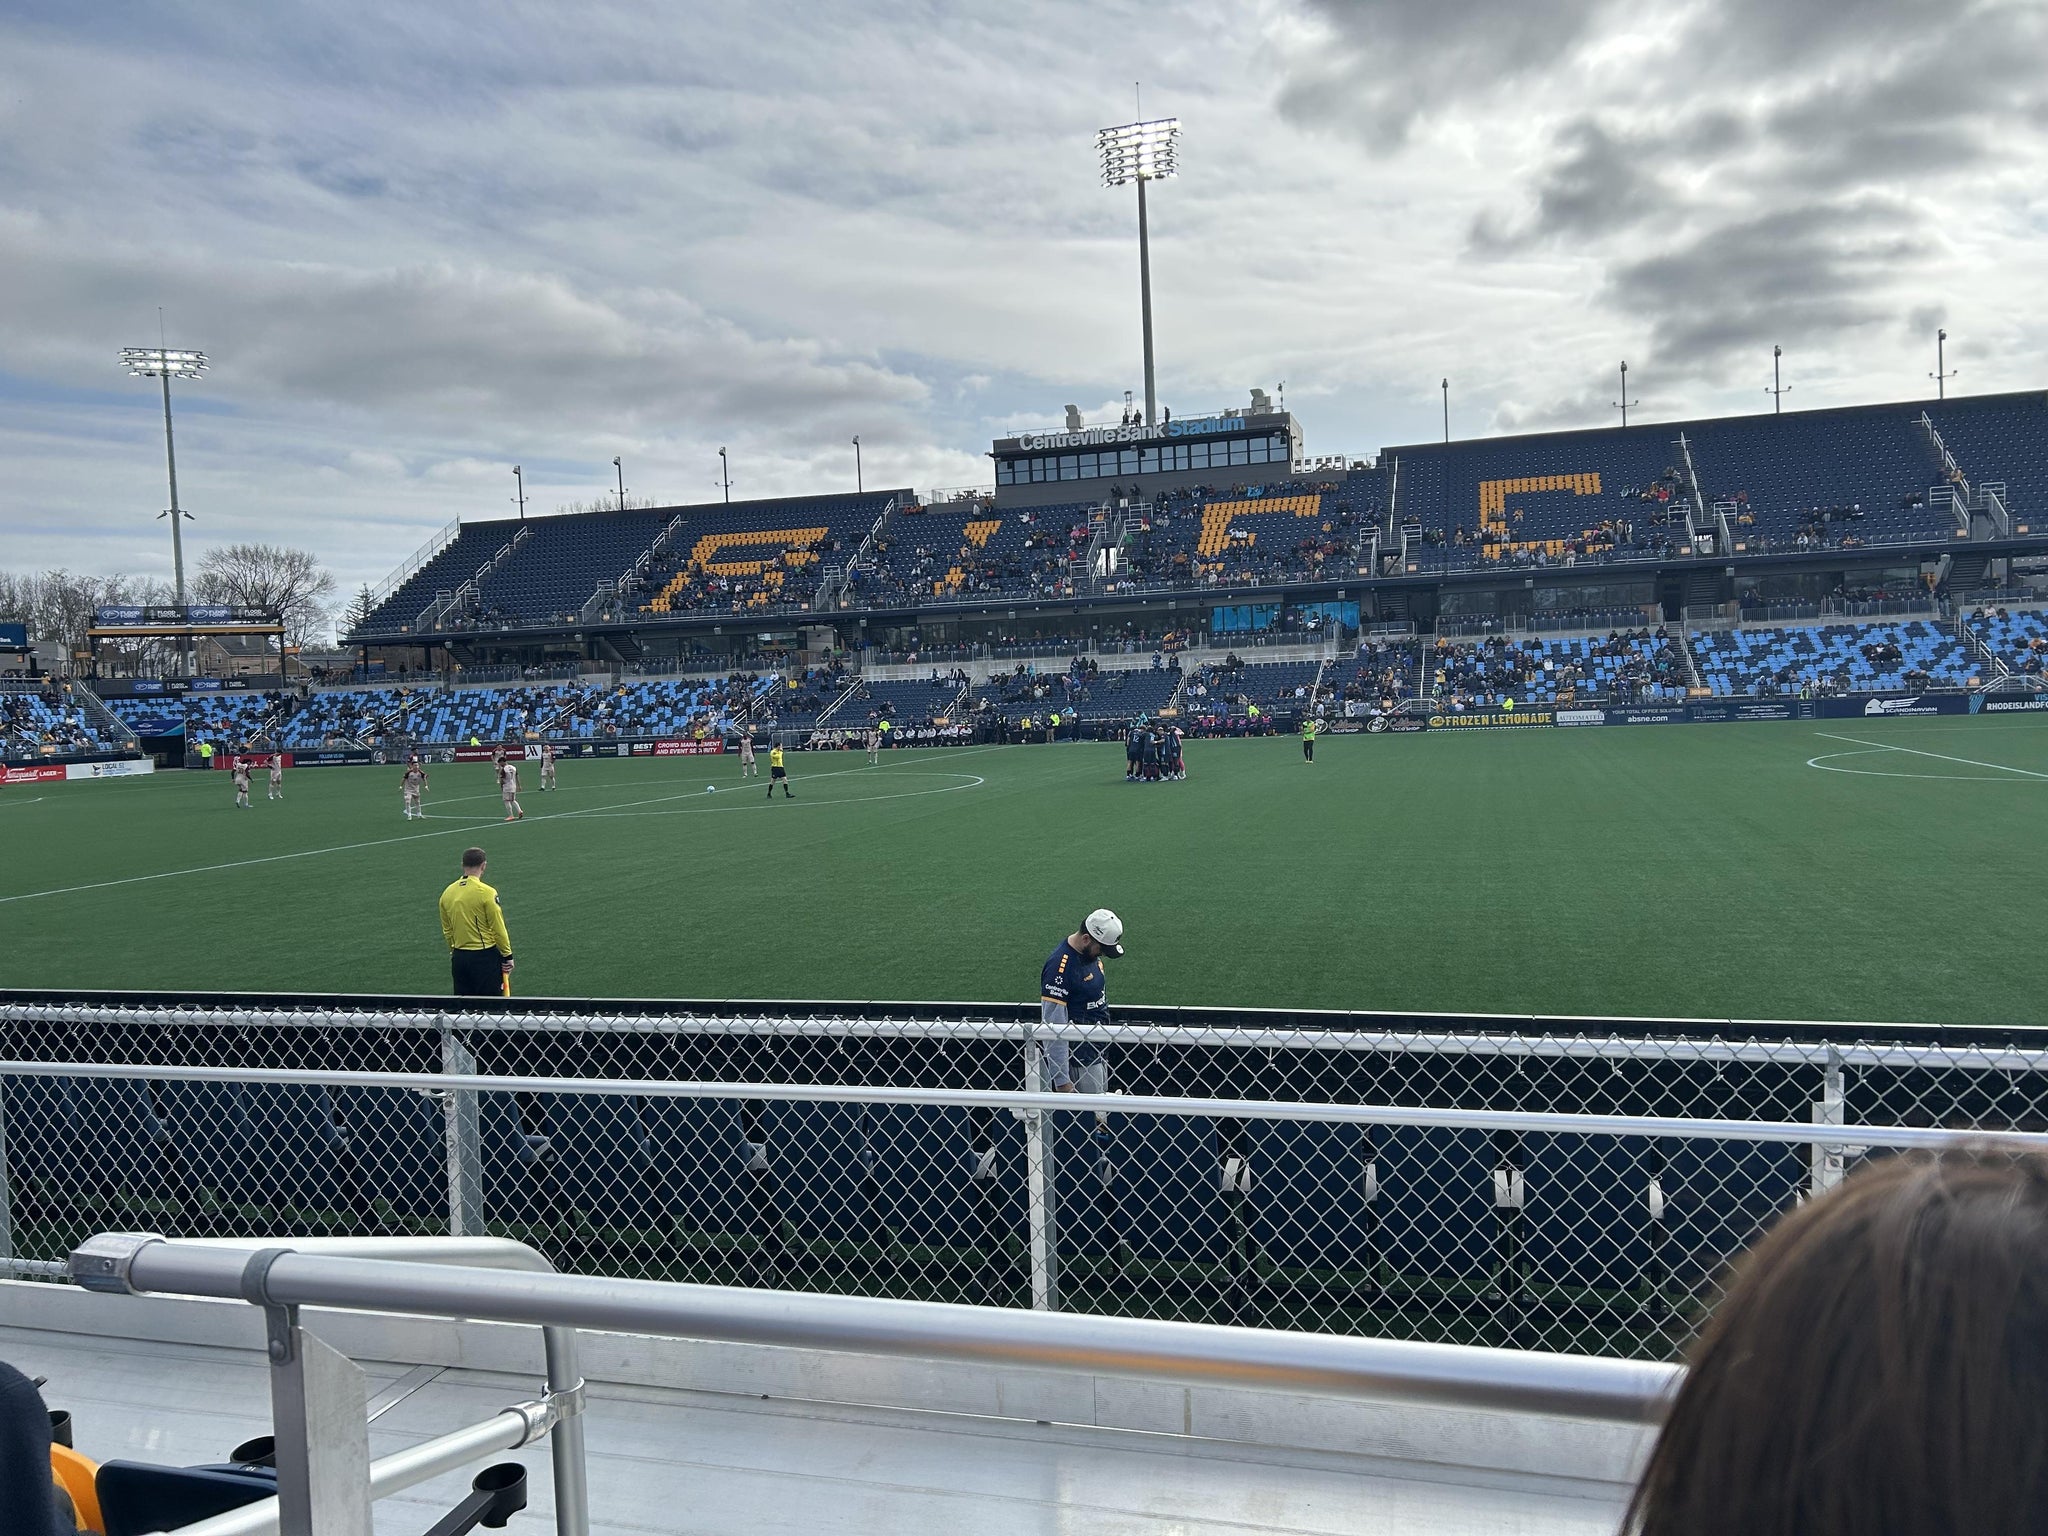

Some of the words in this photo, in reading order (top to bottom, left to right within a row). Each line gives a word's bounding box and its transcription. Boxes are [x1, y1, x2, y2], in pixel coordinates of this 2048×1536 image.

[1168, 416, 1245, 437] Stadium
[1445, 715, 1490, 727] FROZEN
[1492, 712, 1552, 725] LEMONADE
[1627, 715, 1668, 723] absne.com
